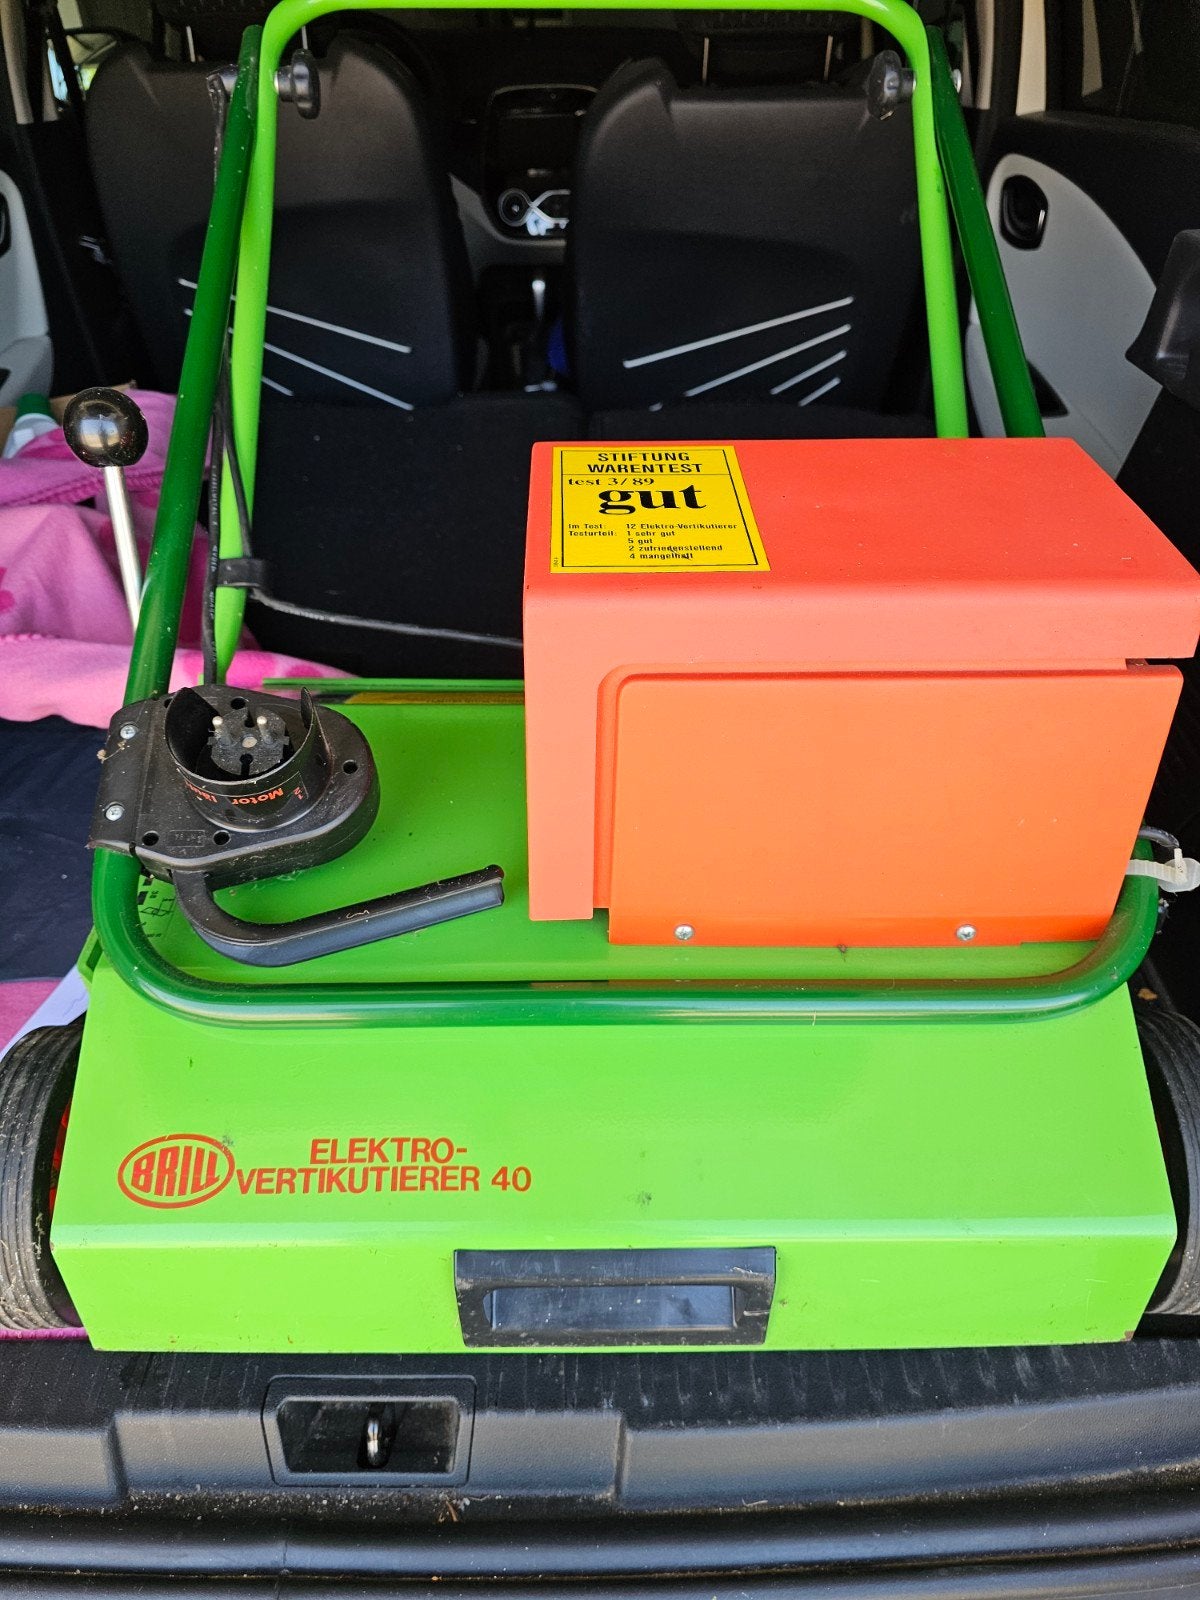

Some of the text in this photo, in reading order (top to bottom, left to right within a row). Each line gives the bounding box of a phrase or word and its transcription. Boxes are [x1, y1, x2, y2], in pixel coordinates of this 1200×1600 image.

[597, 452, 690, 462] STIFTUNG
[587, 464, 702, 473] WARENTEST
[568, 477, 601, 486] test
[598, 484, 707, 515] gut
[660, 530, 676, 538] gut
[639, 544, 723, 552] zufriedenstellend
[639, 551, 694, 560] mangelhaft
[231, 787, 284, 805] Motor
[310, 1137, 468, 1165] ELEKTRO-
[131, 1144, 222, 1197] BRILL
[235, 1165, 532, 1195] VERTIKUTIERER 40
